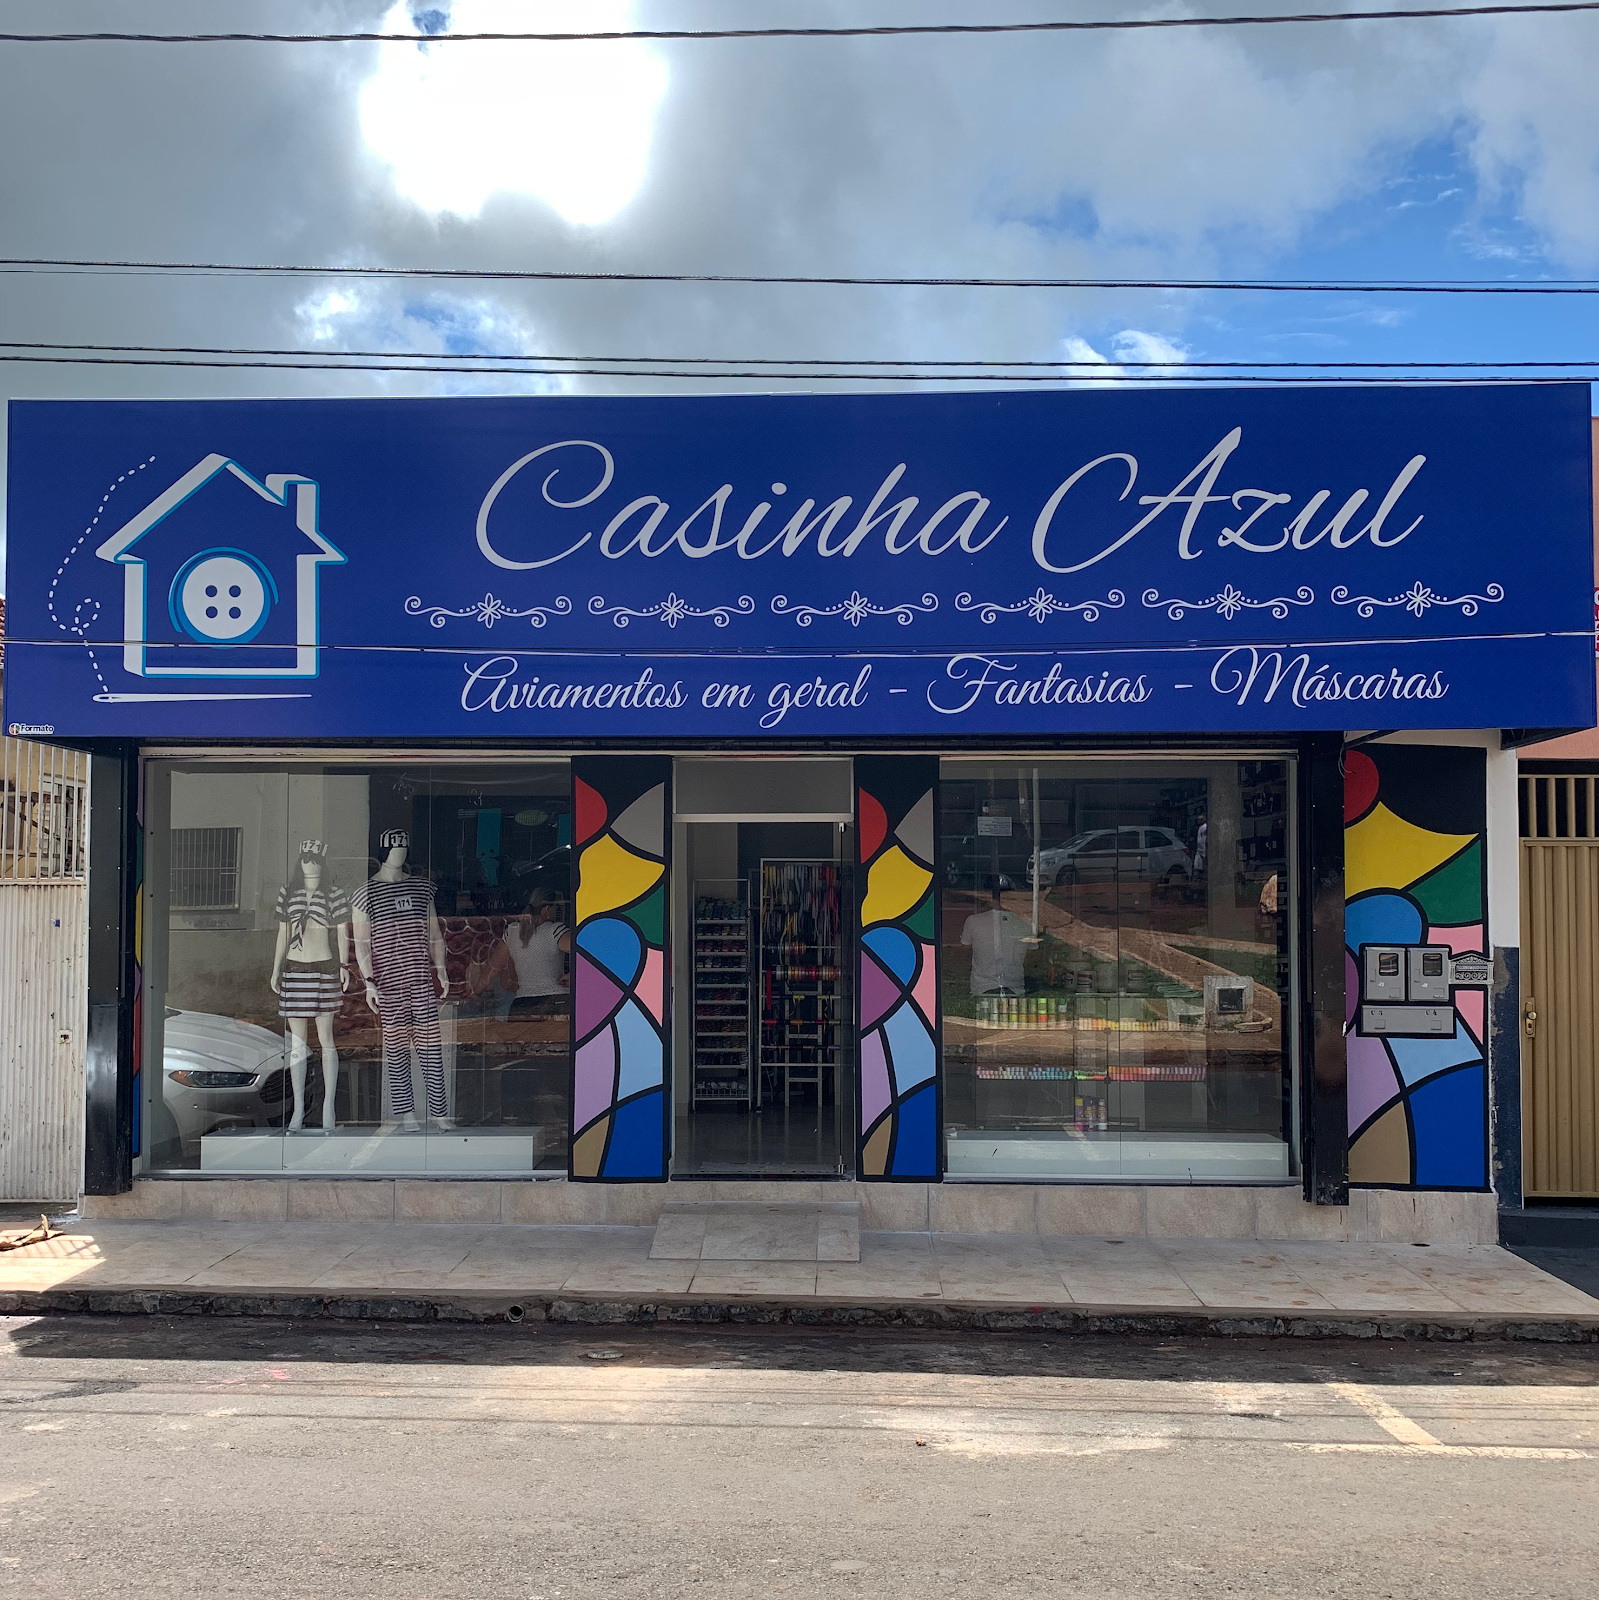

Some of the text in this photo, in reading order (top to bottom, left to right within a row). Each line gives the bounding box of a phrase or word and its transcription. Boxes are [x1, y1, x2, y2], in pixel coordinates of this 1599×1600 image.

[476, 427, 1426, 574] Casinha Azul
[461, 656, 688, 713] Aviamentos
[701, 682, 756, 709] em
[760, 664, 871, 729] geral
[927, 654, 1153, 714] Fantasias
[1210, 646, 1450, 708] Máscaras
[21, 724, 54, 732] Formato
[302, 841, 321, 852] 171
[397, 900, 411, 908] 171
